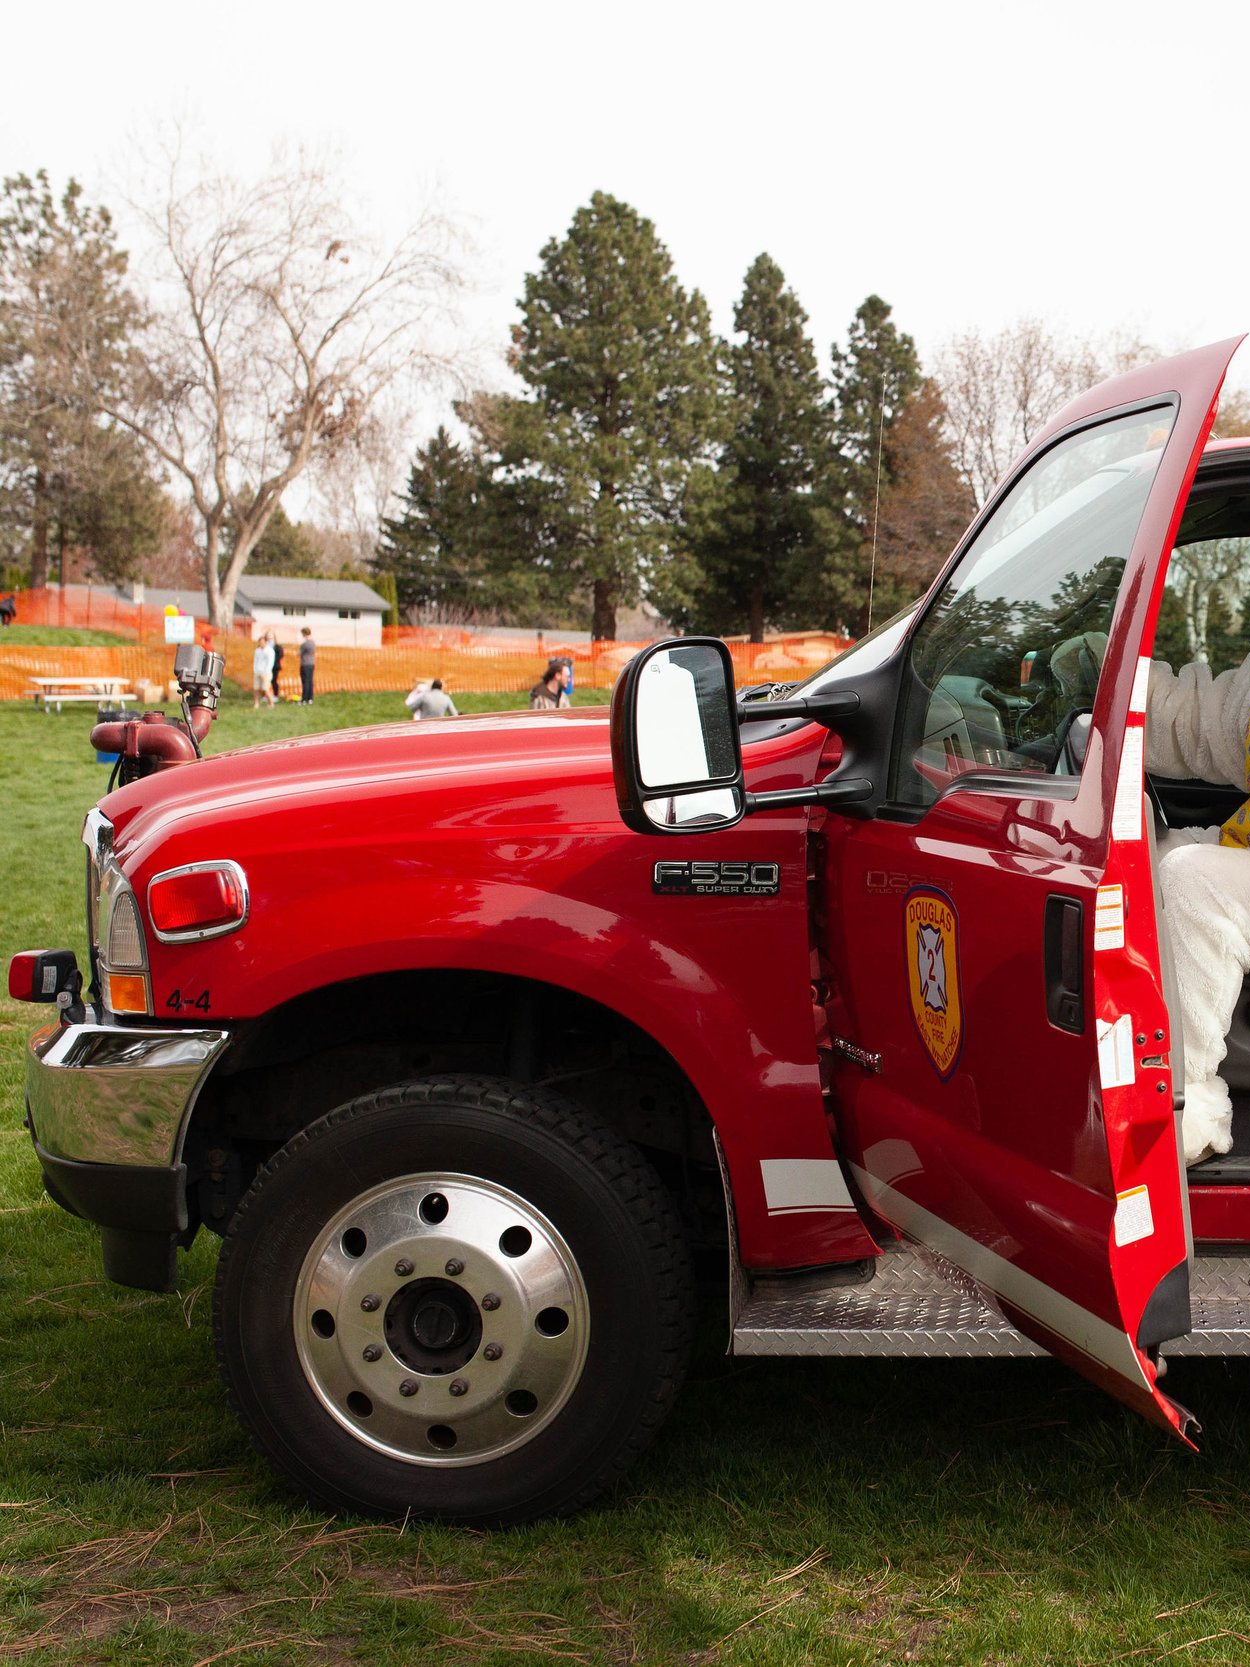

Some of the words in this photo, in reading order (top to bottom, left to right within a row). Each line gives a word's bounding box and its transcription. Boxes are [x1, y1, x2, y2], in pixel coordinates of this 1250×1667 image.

[696, 885, 739, 893] SUPER
[909, 901, 952, 933] DOUGLAS
[927, 948, 936, 982] 2
[166, 989, 211, 1013] 4-4
[925, 1010, 947, 1029] COUNTY
[932, 1028, 945, 1045] FIRE
